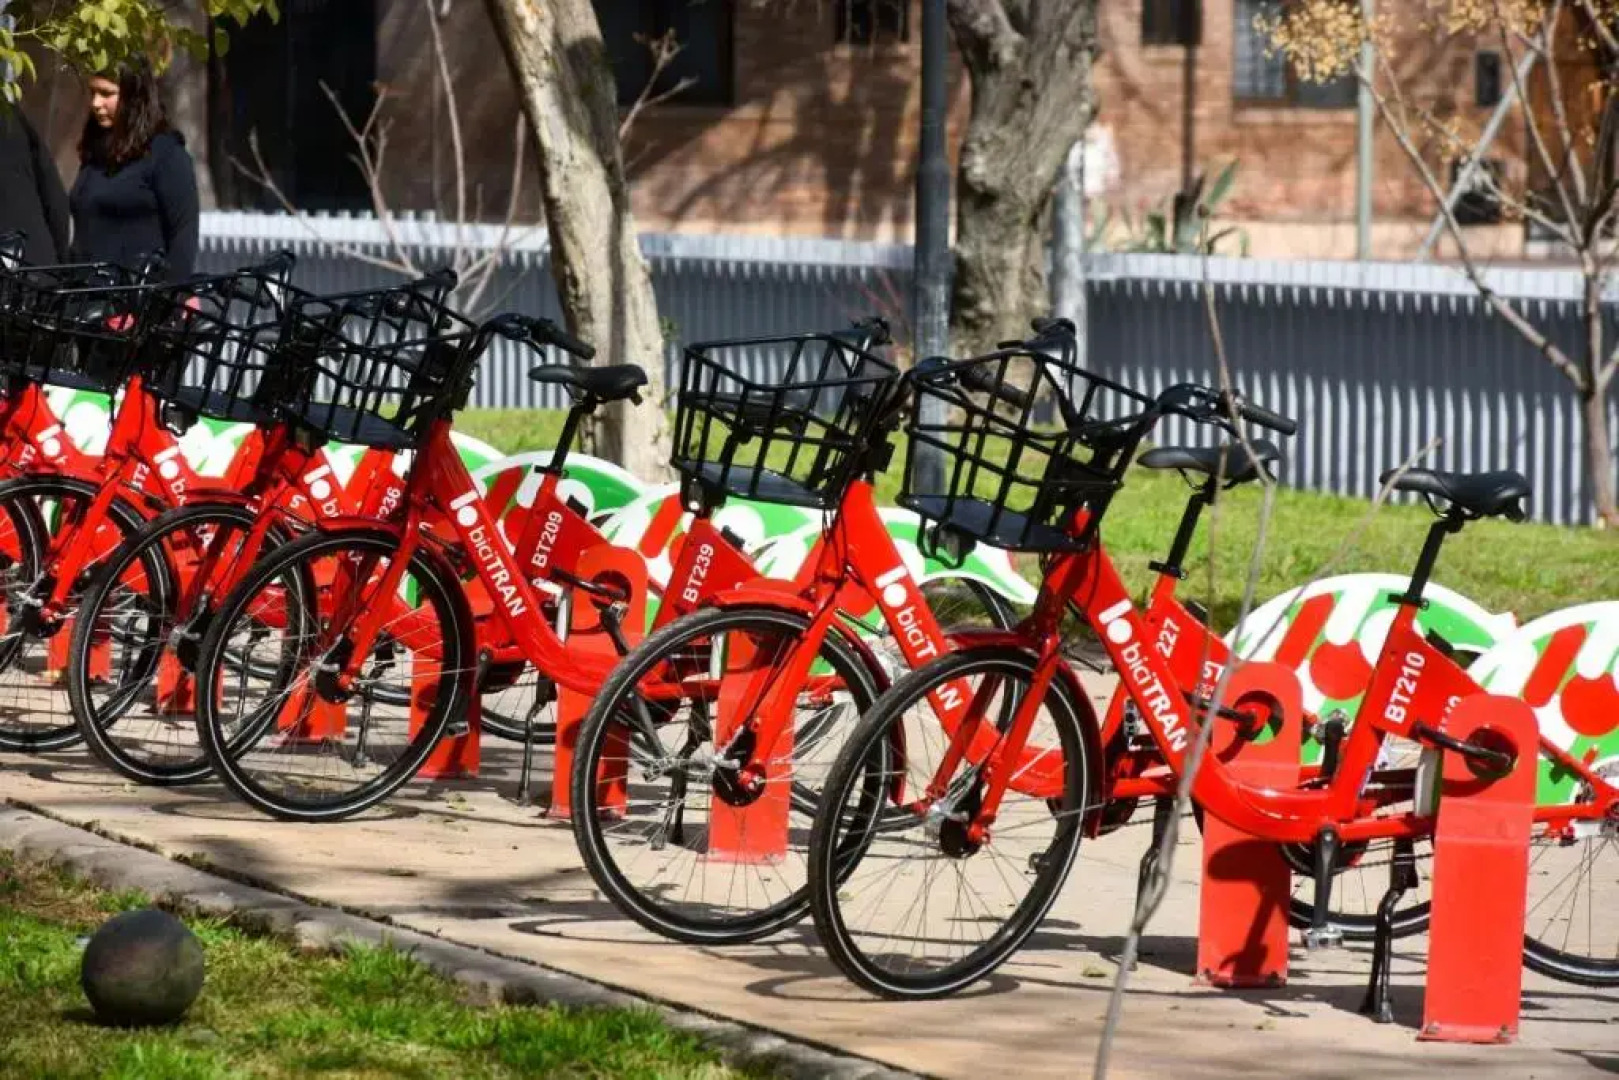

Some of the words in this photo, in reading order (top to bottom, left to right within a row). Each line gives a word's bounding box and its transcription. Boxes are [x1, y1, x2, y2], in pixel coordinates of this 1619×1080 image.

[468, 525, 528, 618] biciTRAN
[531, 511, 563, 568] BT209
[683, 543, 714, 604] BT239
[896, 606, 962, 711] biciTN
[1155, 617, 1181, 659] 227
[1121, 642, 1188, 752] biciTRAN
[1384, 652, 1425, 724] BT210
